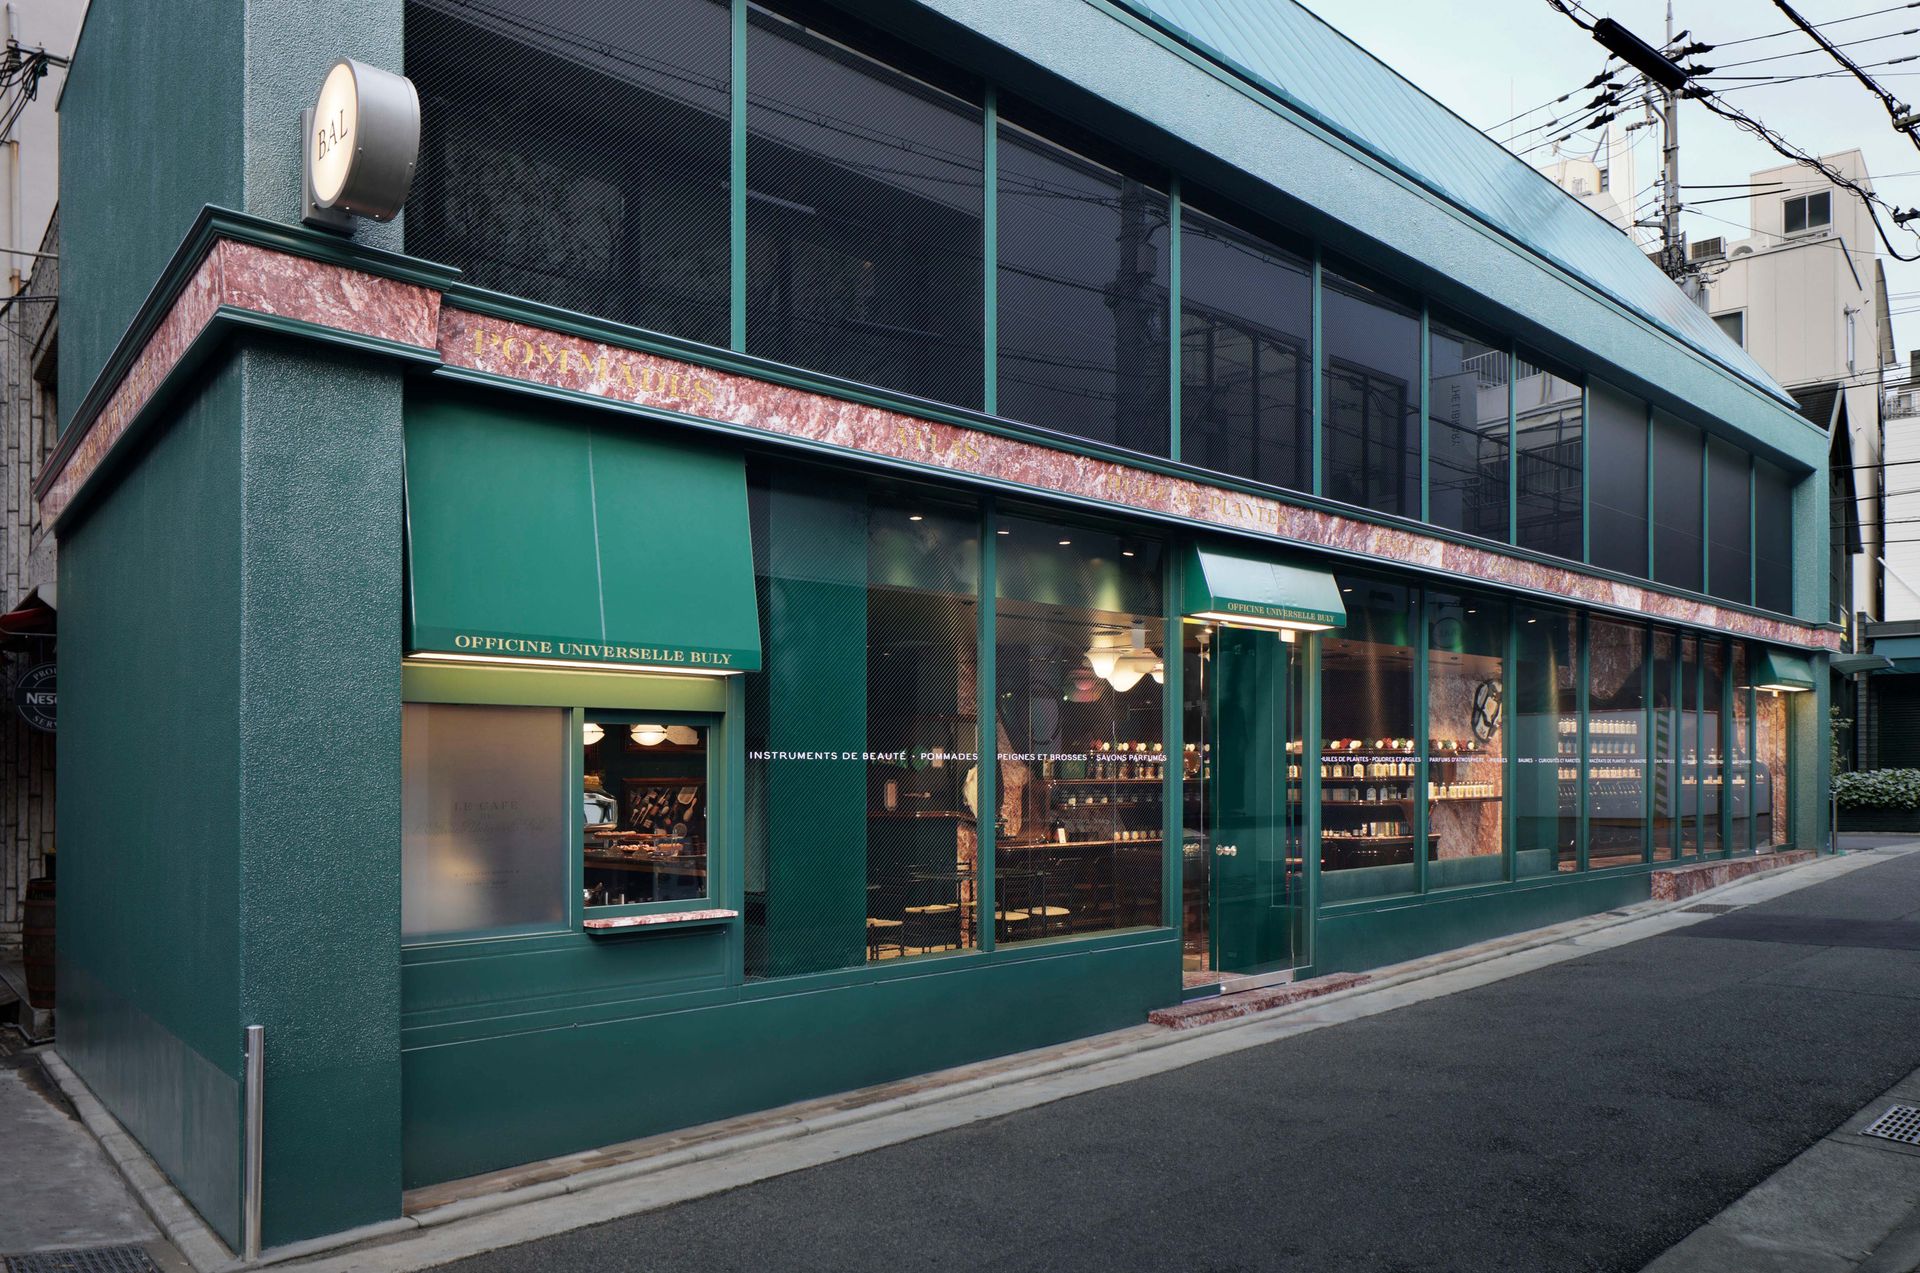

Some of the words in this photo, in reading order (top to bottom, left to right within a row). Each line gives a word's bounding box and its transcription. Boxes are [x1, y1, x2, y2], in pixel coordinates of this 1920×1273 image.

[318, 108, 349, 161] BAL
[473, 328, 715, 404] POMMADES
[1227, 602, 1265, 614] OFFICINE
[1266, 607, 1316, 620] UNIVERSELLE
[1317, 613, 1335, 623] BULY
[455, 635, 552, 654] OFFICINE
[559, 642, 685, 662] UNIVERSELLE
[691, 651, 732, 665] BULY
[749, 751, 838, 760] INSTRUMENTS
[842, 751, 858, 760] DE
[862, 750, 907, 761] BEAUTÉ
[920, 752, 979, 761] POMMADES
[997, 753, 1036, 761] PEIGNES
[1037, 753, 1049, 761] ET
[1050, 753, 1088, 761] BROSSES
[1096, 754, 1128, 762] SAVONS
[1128, 753, 1167, 762] PARFUMÉS
